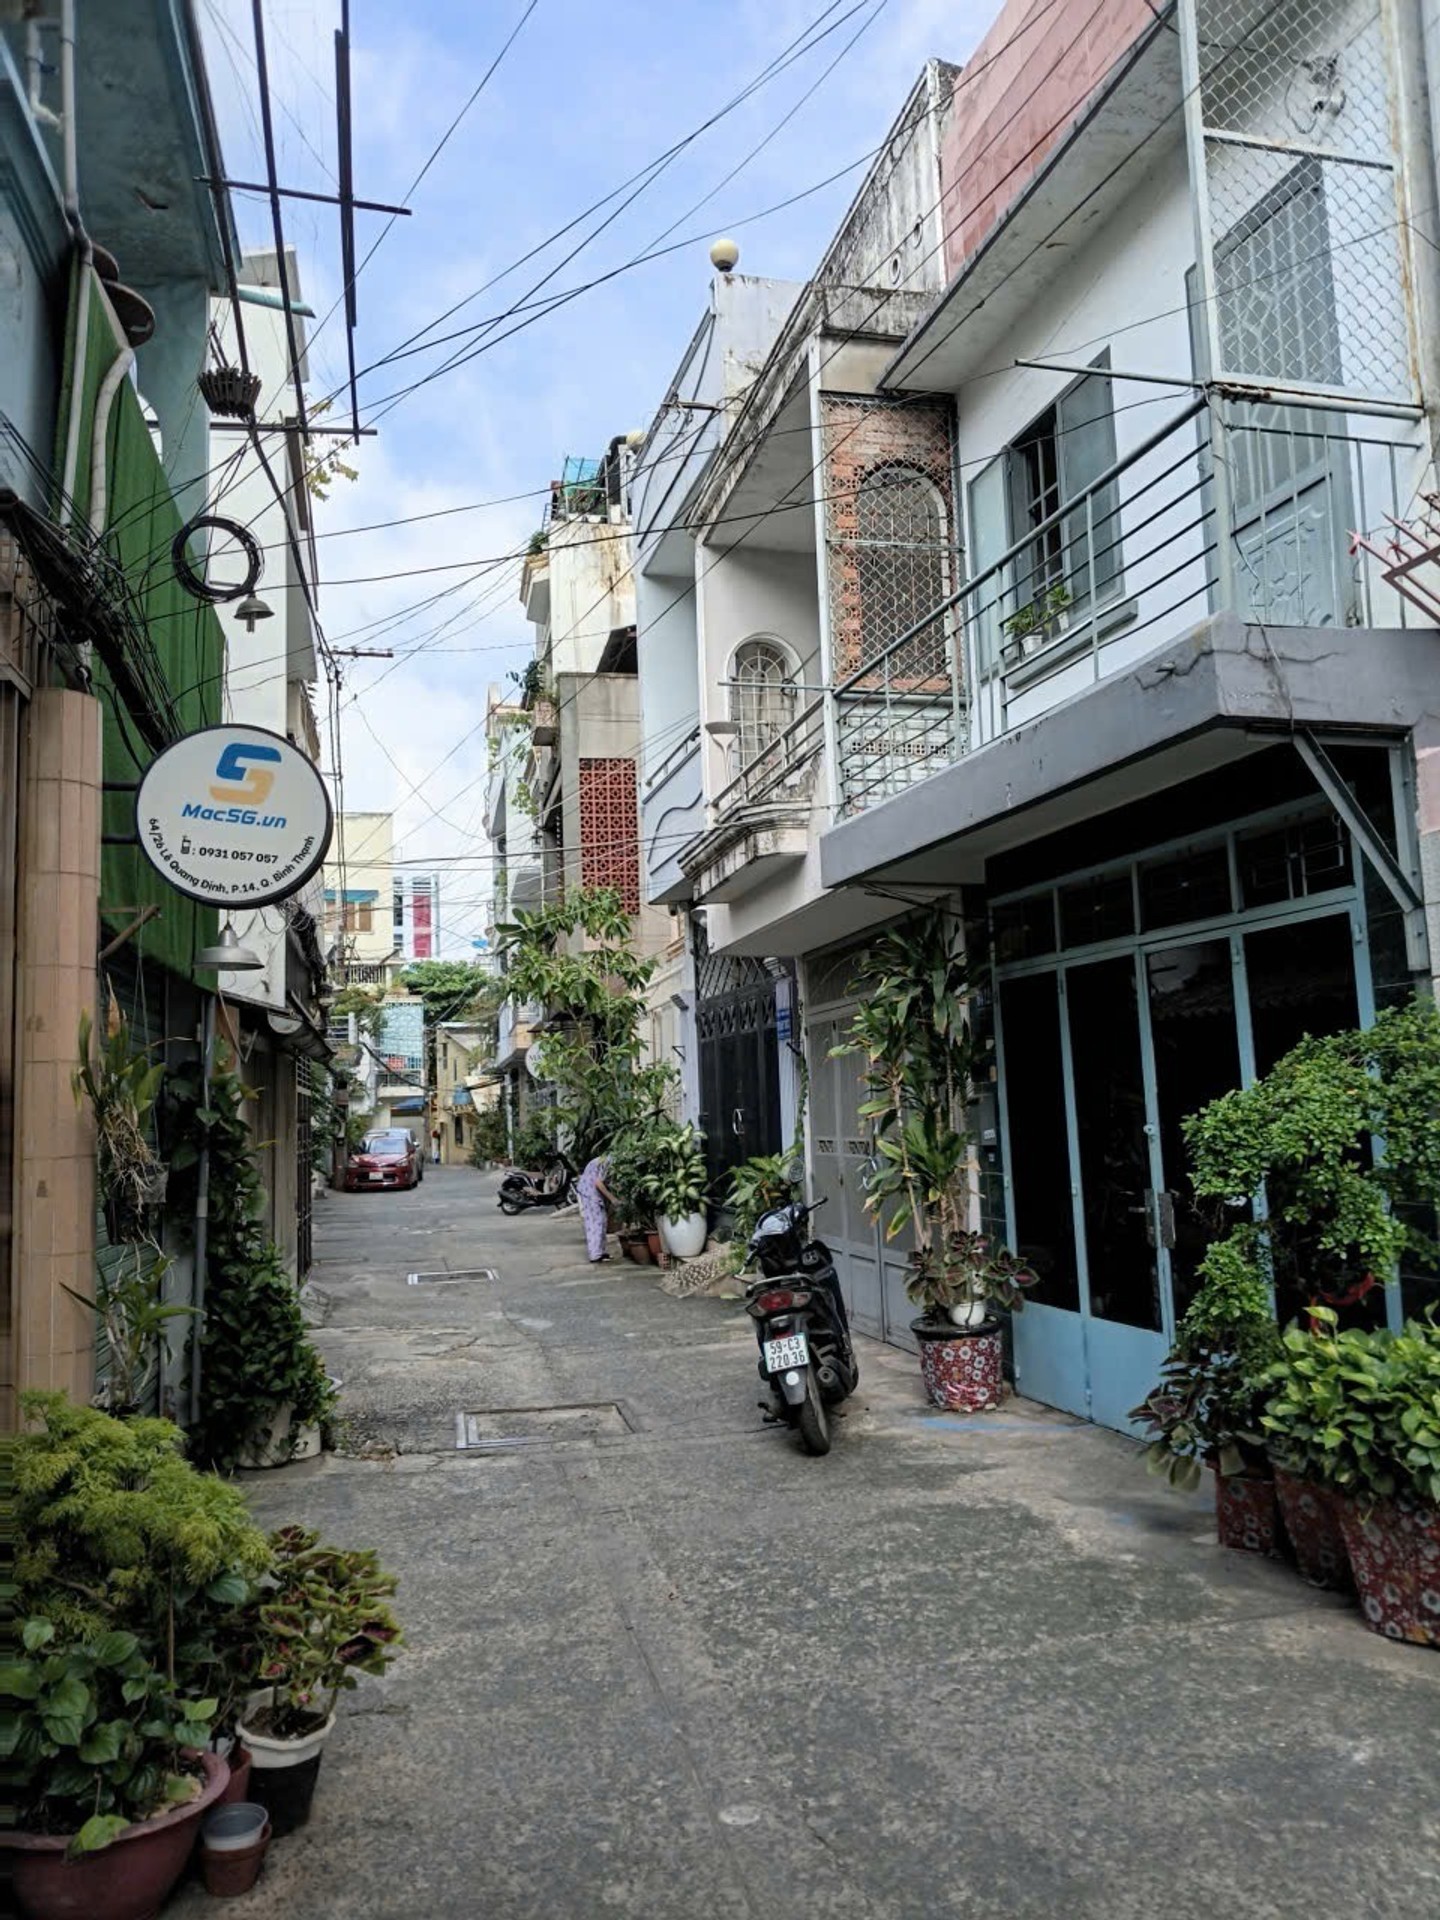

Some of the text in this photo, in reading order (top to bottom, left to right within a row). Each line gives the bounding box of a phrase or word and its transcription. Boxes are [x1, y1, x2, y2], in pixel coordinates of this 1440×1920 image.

[181, 803, 287, 829] MacSG.vn
[199, 847, 278, 864] 0931 057 057
[170, 860, 199, 887] Quang
[769, 1337, 800, 1355] 59-C3
